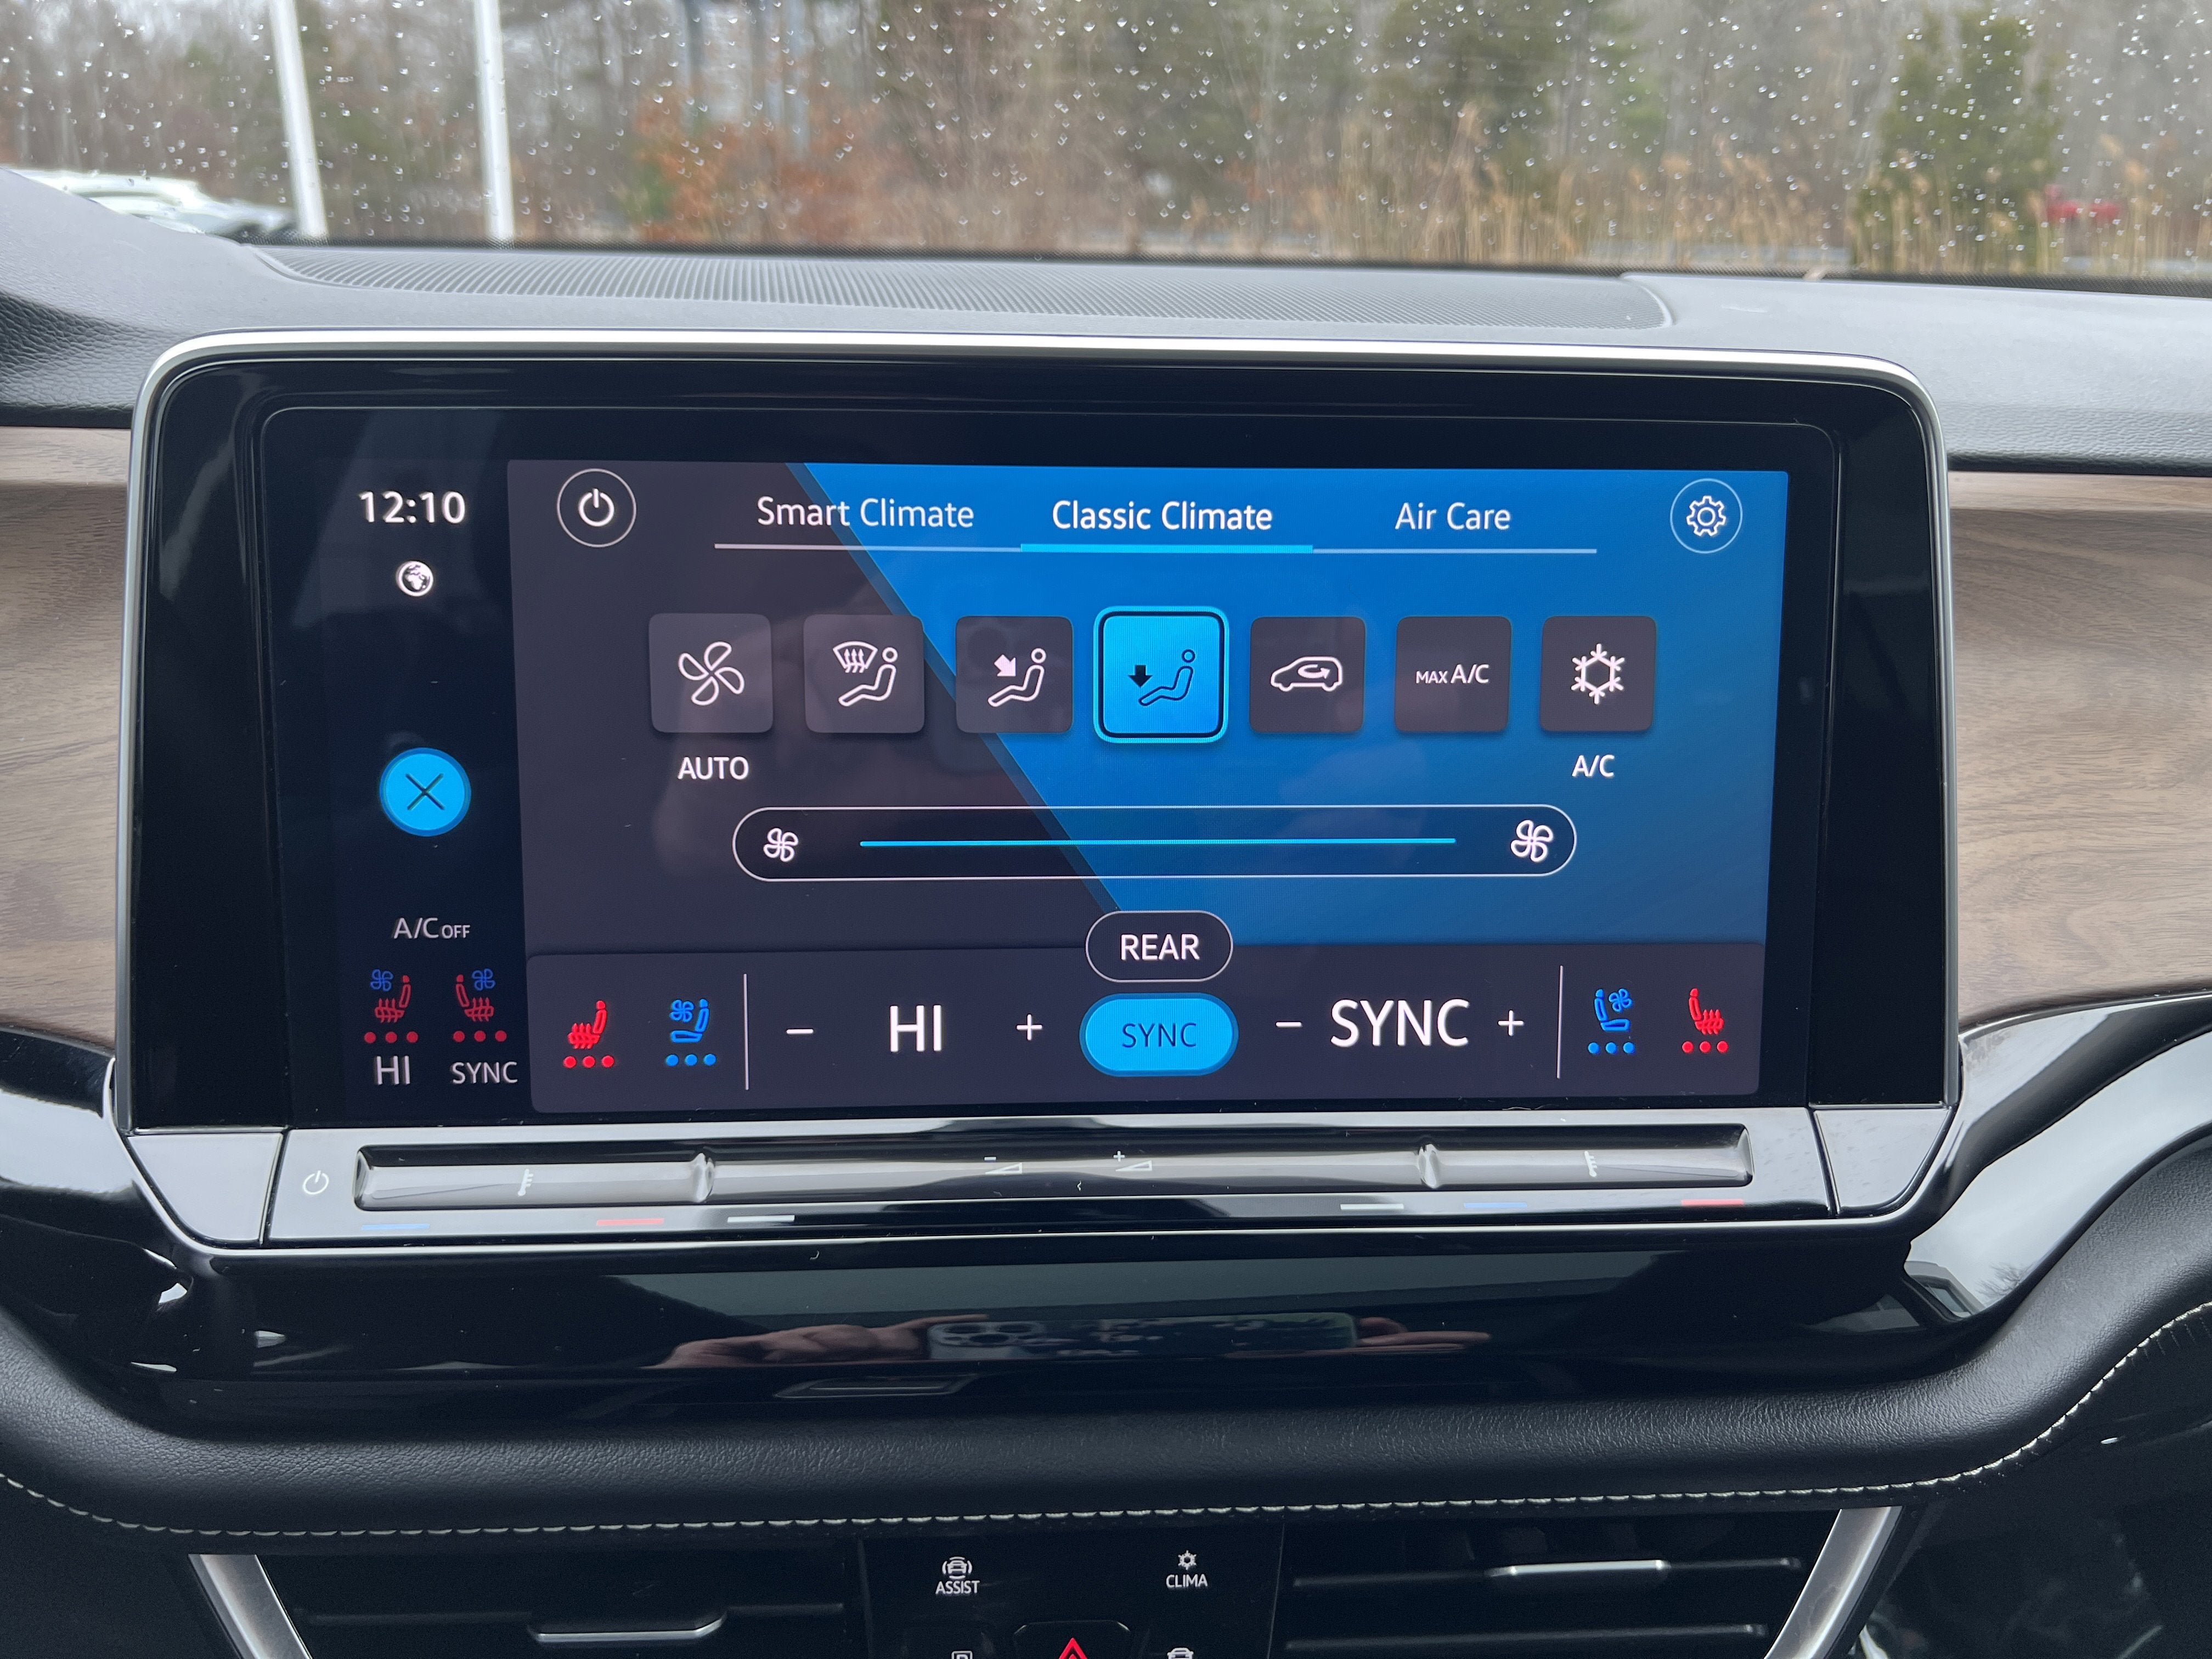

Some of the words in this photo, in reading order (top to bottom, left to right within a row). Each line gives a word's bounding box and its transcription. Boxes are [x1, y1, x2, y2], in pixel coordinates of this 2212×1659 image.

[359, 491, 466, 524] 12:10
[757, 496, 850, 527] Smart
[860, 498, 974, 528] Climate
[1052, 500, 1151, 530] Classic
[1161, 500, 1273, 531] Climate
[1395, 502, 1437, 530] Air
[1447, 502, 1511, 531] Care
[1416, 670, 1448, 684] MAX
[1450, 664, 1489, 684] A/C
[678, 756, 749, 780] AUTO
[1572, 754, 1615, 778] A/C
[1121, 934, 1200, 961] REAR
[890, 1005, 942, 1052] HI
[1121, 1022, 1197, 1048] SYNC
[1330, 998, 1469, 1047] SYNC
[376, 1056, 410, 1085] HI
[452, 1061, 518, 1084] SYNC
[935, 1580, 980, 1594] ASSIST
[1166, 1573, 1208, 1588] CLIMA
